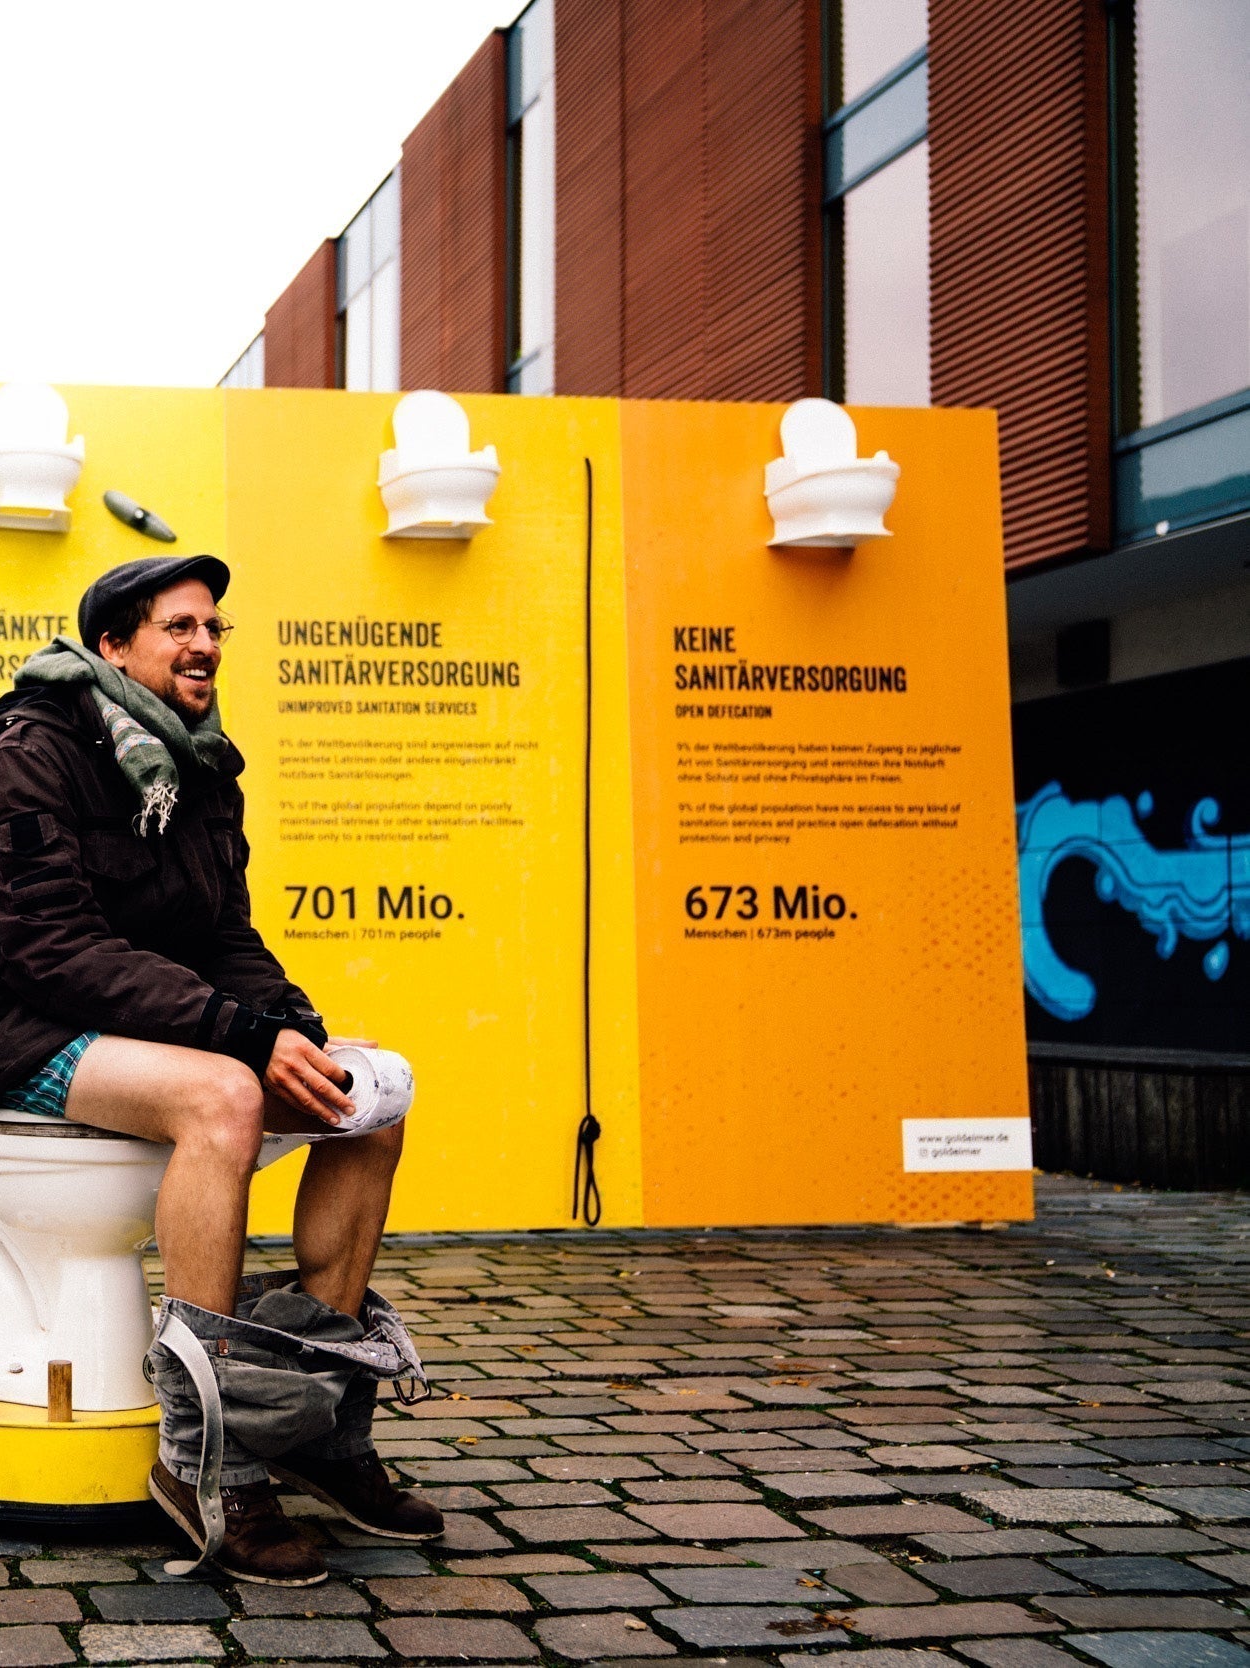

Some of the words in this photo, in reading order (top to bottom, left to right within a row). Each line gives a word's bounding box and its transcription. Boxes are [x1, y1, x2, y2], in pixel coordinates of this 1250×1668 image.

[278, 616, 442, 648] UNGENÜGENDE
[674, 626, 736, 652] KEINE
[279, 654, 520, 687] SANITÄRVERSORGUNG
[675, 660, 907, 693] SANITÄRVERSORGUNG
[277, 700, 353, 713] UNIMPROVED
[356, 701, 421, 714] SANITATION
[424, 701, 477, 715] SERVICES
[674, 704, 704, 718] OPEN
[706, 704, 772, 718] DEFECATION
[284, 885, 356, 919] 701
[377, 885, 464, 919] Mio.
[684, 885, 759, 920] 673
[772, 884, 858, 920] Mio.
[283, 929, 350, 939] Menschen
[360, 928, 396, 939] 701m
[399, 929, 442, 940] people
[684, 928, 748, 939] Menschen
[756, 927, 792, 939] 673m
[794, 927, 836, 940] people
